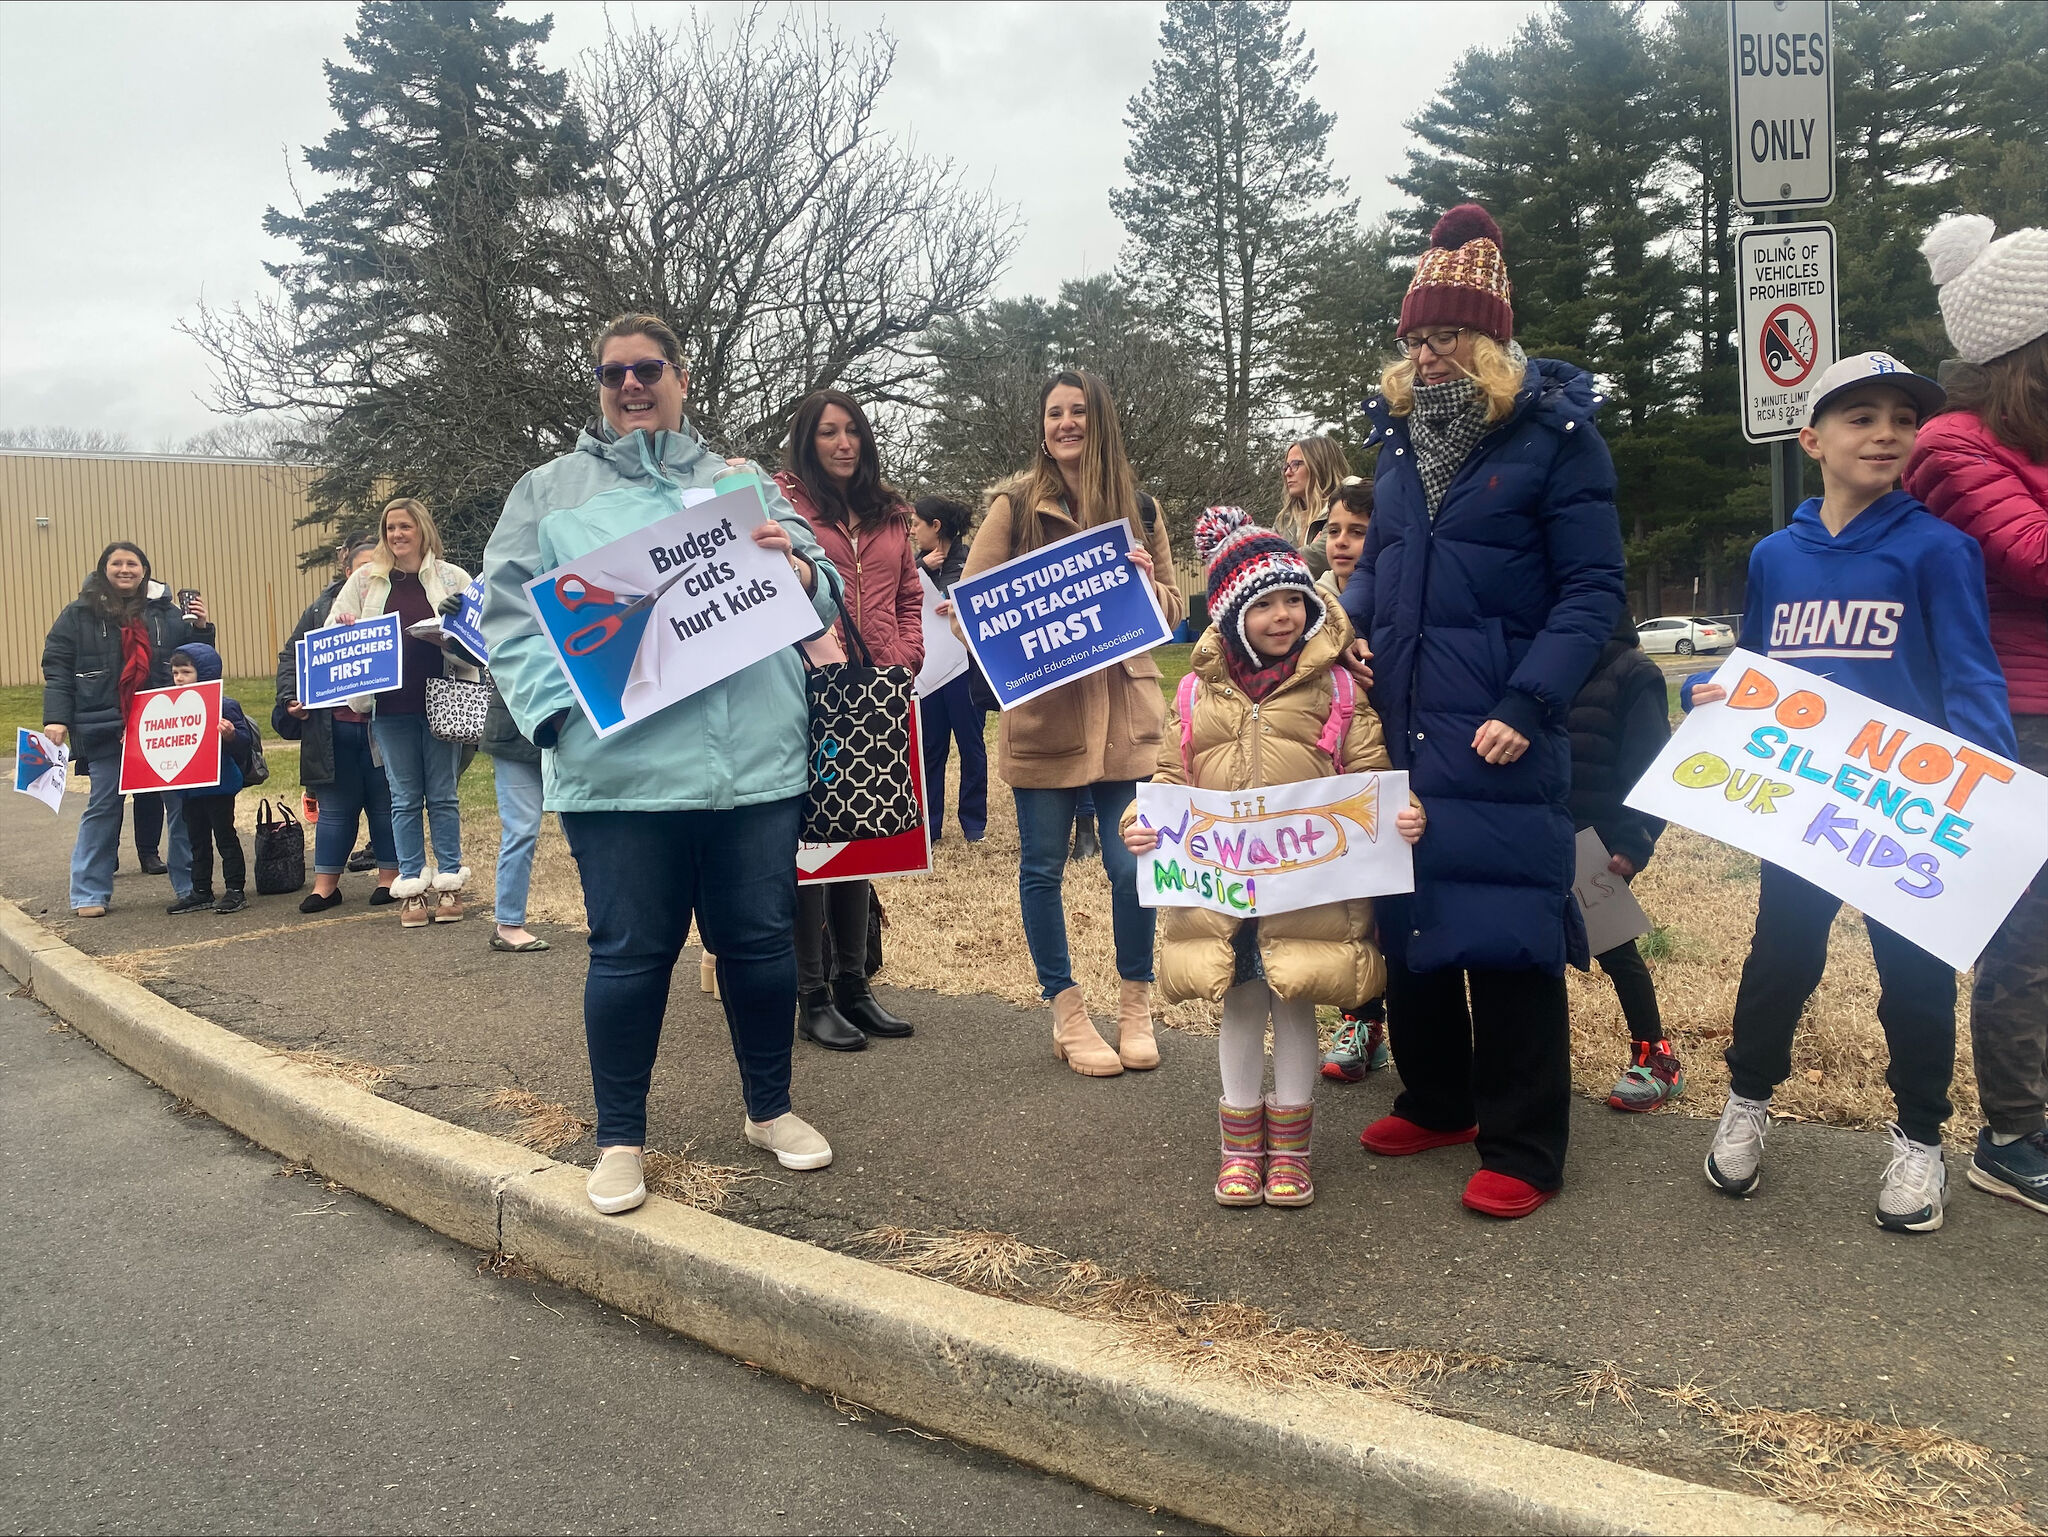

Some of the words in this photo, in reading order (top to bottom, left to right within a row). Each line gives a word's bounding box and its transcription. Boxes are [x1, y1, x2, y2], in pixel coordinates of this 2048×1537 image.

[1740, 32, 1824, 76] BUSES
[1751, 118, 1815, 163] ONLY
[1754, 247, 1796, 264] IDLING
[1802, 245, 1819, 260] OF
[1756, 263, 1819, 281] VEHICLES
[1750, 280, 1825, 301] PROHIBITED
[1753, 397, 1759, 408] 3
[1761, 394, 1788, 407] MINUTE
[1757, 409, 1776, 421] RCSA
[649, 517, 737, 575] Budget
[684, 560, 736, 597] cuts
[970, 583, 1010, 615] PUT
[1011, 541, 1118, 598] STUDENTS
[669, 600, 727, 641] hurt
[724, 578, 778, 616] kids
[978, 609, 1022, 642] AND
[1021, 565, 1130, 621] TEACHERS
[1770, 600, 1904, 647] GIANTS
[312, 637, 332, 652] PUT
[333, 625, 392, 647] STUDENTS
[1019, 604, 1103, 661] FIRST
[311, 652, 335, 667] AND
[334, 639, 394, 661] TEACHERS
[330, 657, 373, 683] FIRST
[1005, 668, 1043, 691] Stamford
[1044, 648, 1090, 674] Education
[1092, 626, 1145, 655] Association
[336, 682, 360, 692] Education
[359, 676, 390, 687] Association
[144, 716, 179, 732] THANK
[180, 714, 202, 728] YOU
[145, 733, 198, 750] TEACHERS
[1726, 667, 1827, 730] DO
[1846, 719, 2016, 814] NOT
[160, 760, 179, 771] CEA
[1744, 726, 1975, 859] SILENCE
[1672, 751, 1794, 814] OUR
[1803, 803, 1944, 899] KIDS
[1154, 858, 1257, 914] Music!
